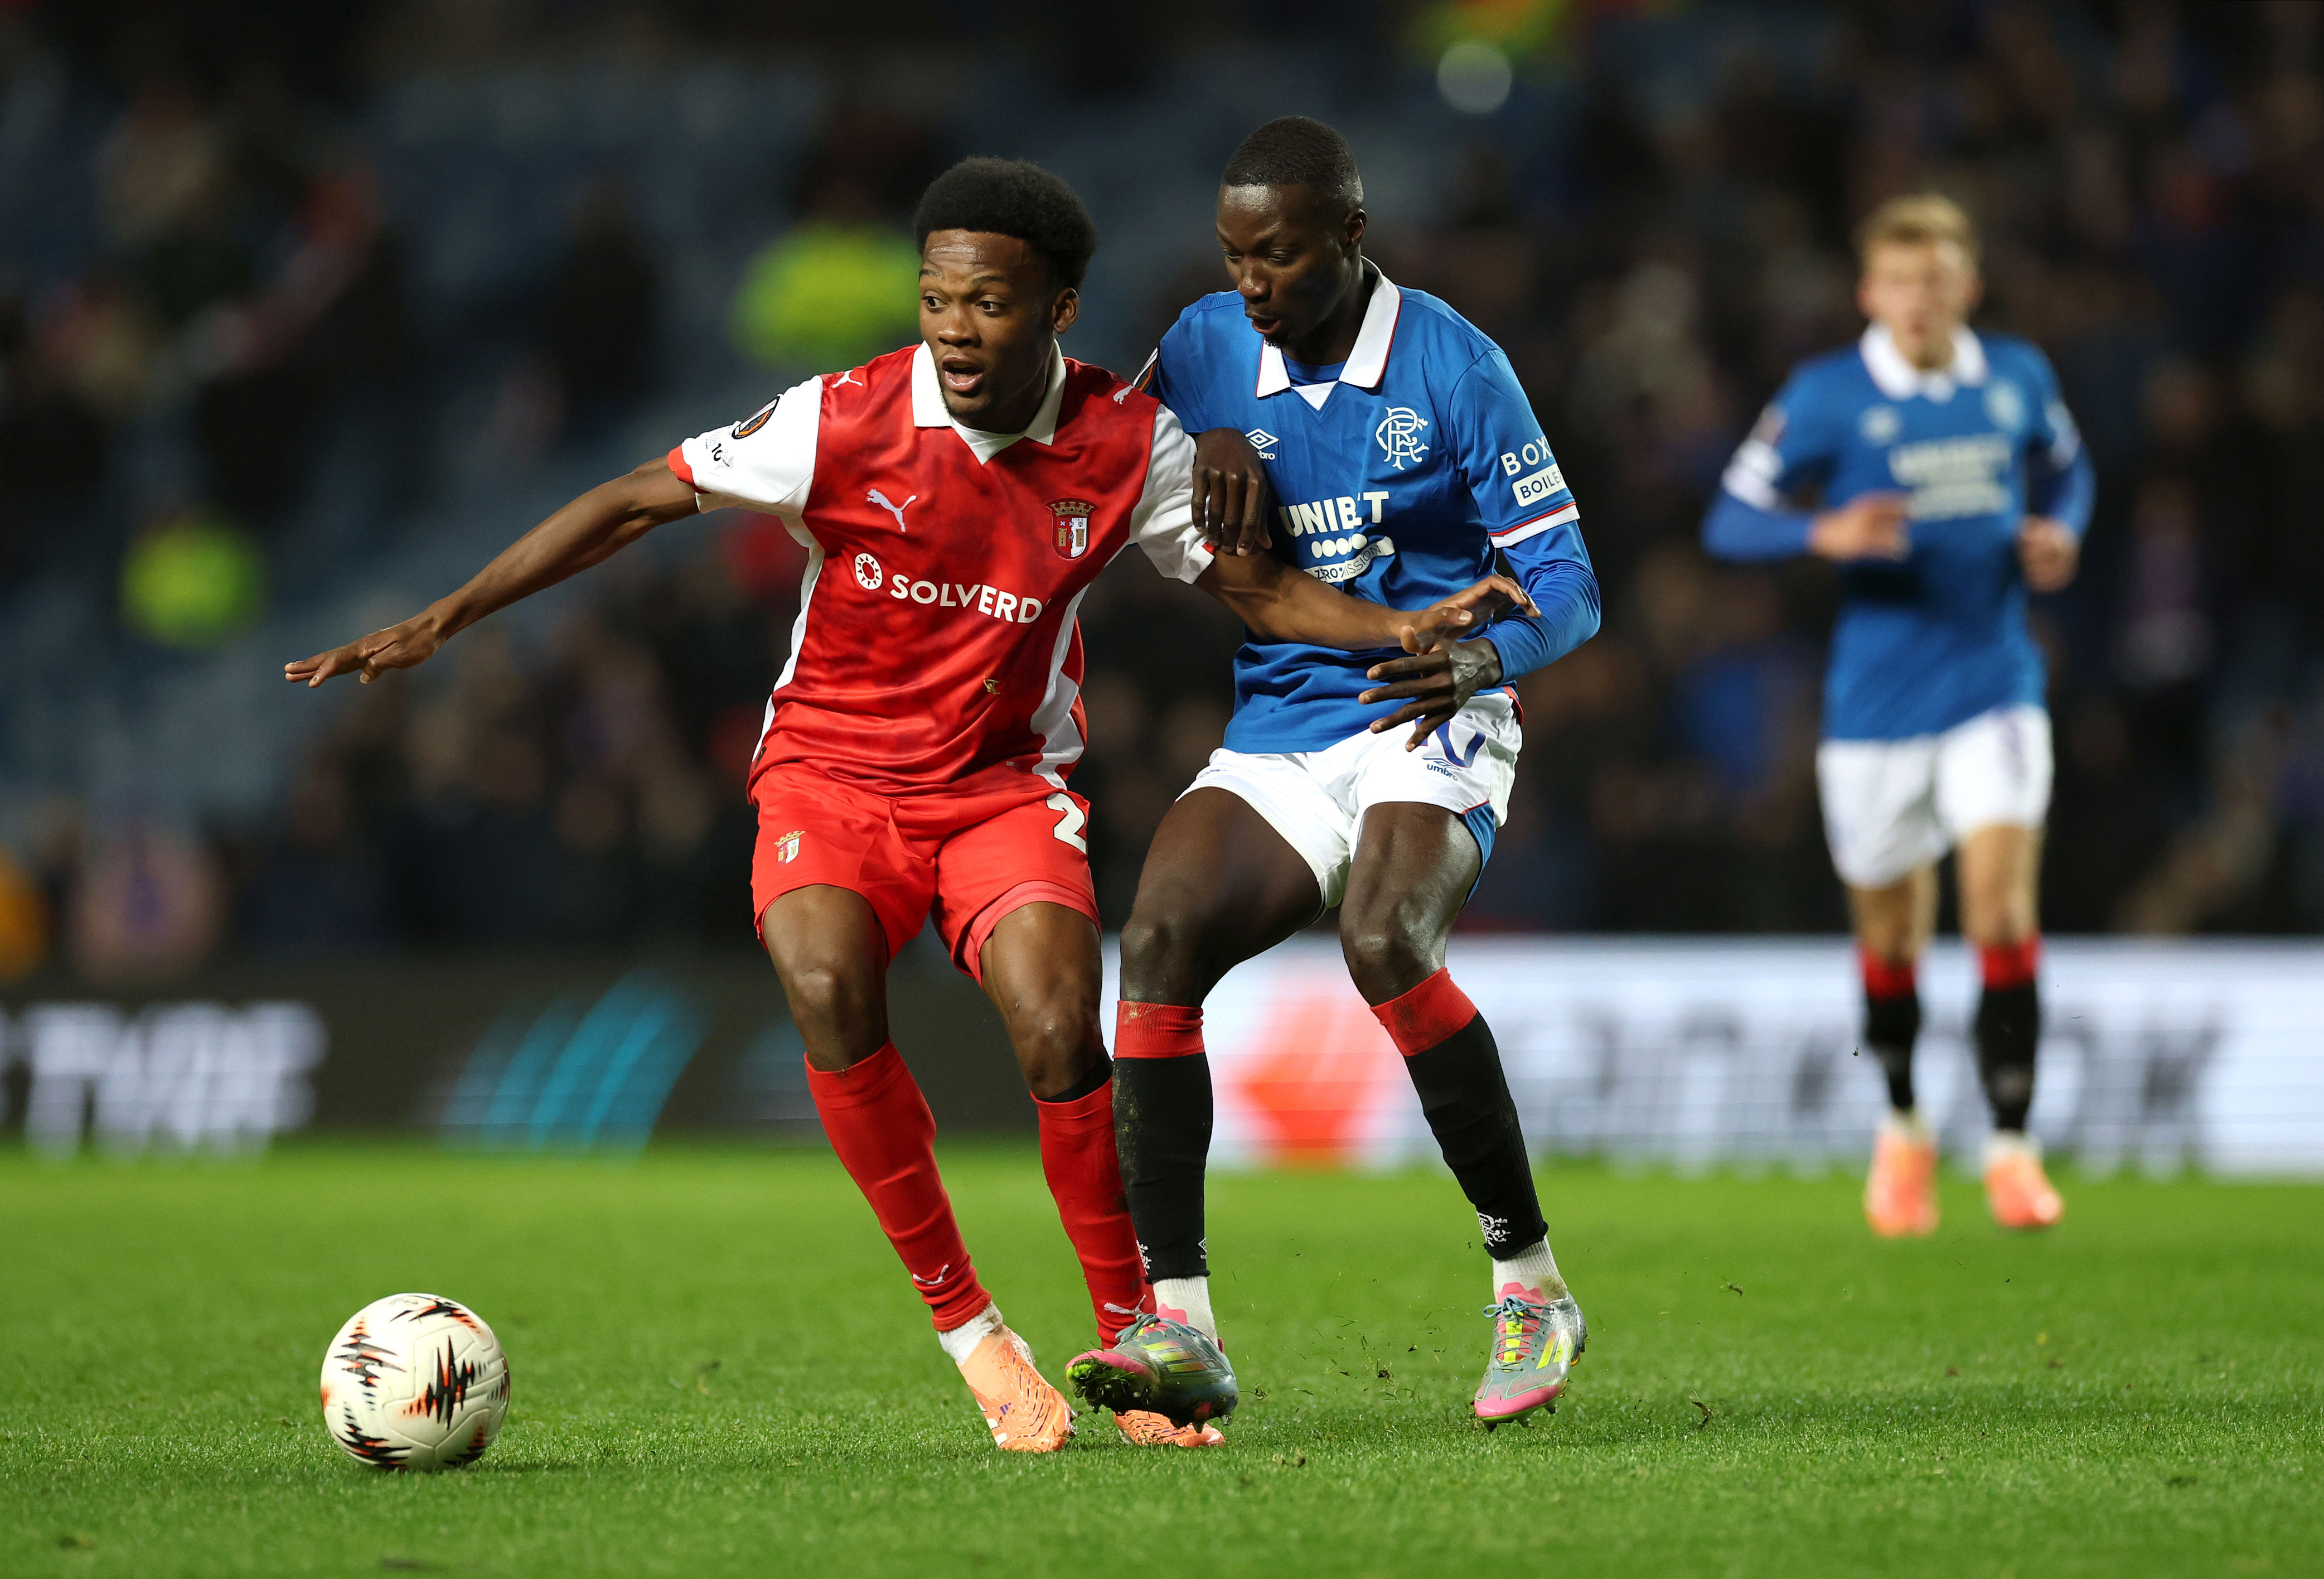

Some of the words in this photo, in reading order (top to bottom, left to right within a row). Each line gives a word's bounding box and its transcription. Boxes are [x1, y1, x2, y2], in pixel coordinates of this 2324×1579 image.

[1257, 450, 1276, 460] bro
[1500, 436, 1552, 476] BOX
[1278, 491, 1389, 537] UNIBT
[890, 574, 1050, 623] SOLVERD
[1426, 763, 1458, 781] umbro
[1046, 792, 1087, 855] 2
